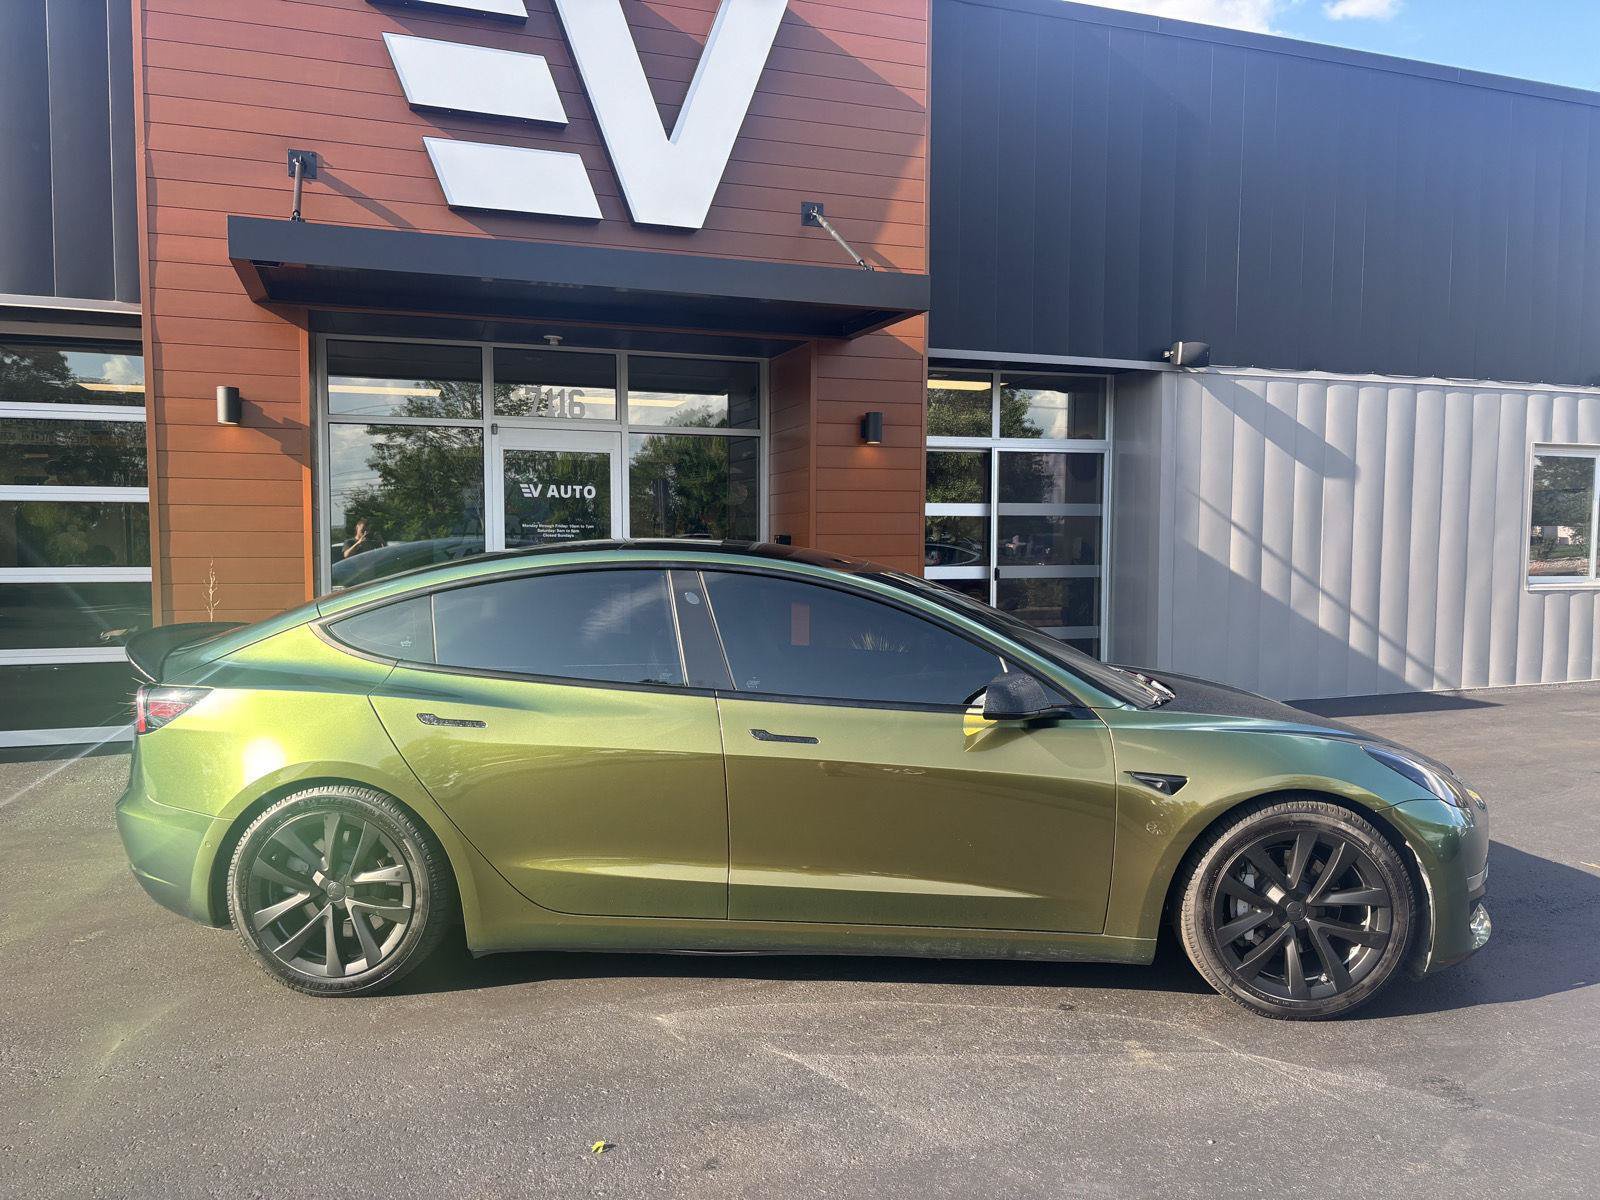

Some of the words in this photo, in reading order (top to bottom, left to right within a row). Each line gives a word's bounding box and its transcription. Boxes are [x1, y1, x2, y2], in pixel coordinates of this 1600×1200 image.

[525, 387, 586, 418] 7116
[520, 483, 542, 498] EV
[546, 484, 596, 499] AUTO
